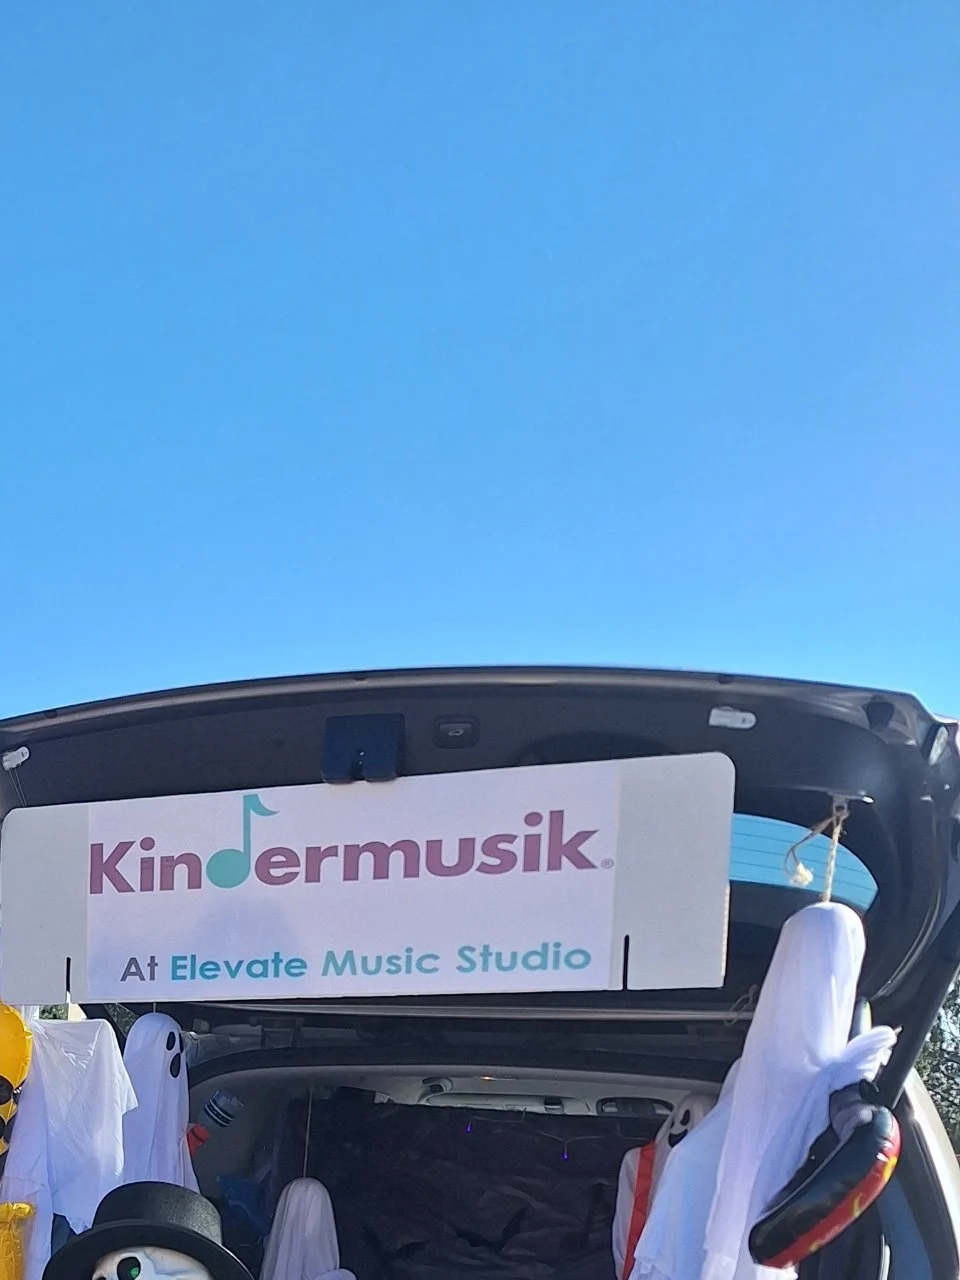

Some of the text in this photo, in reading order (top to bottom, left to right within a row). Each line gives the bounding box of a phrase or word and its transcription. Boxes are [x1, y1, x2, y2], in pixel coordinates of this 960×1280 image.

[120, 941, 592, 982] At Elevate Music Studio
